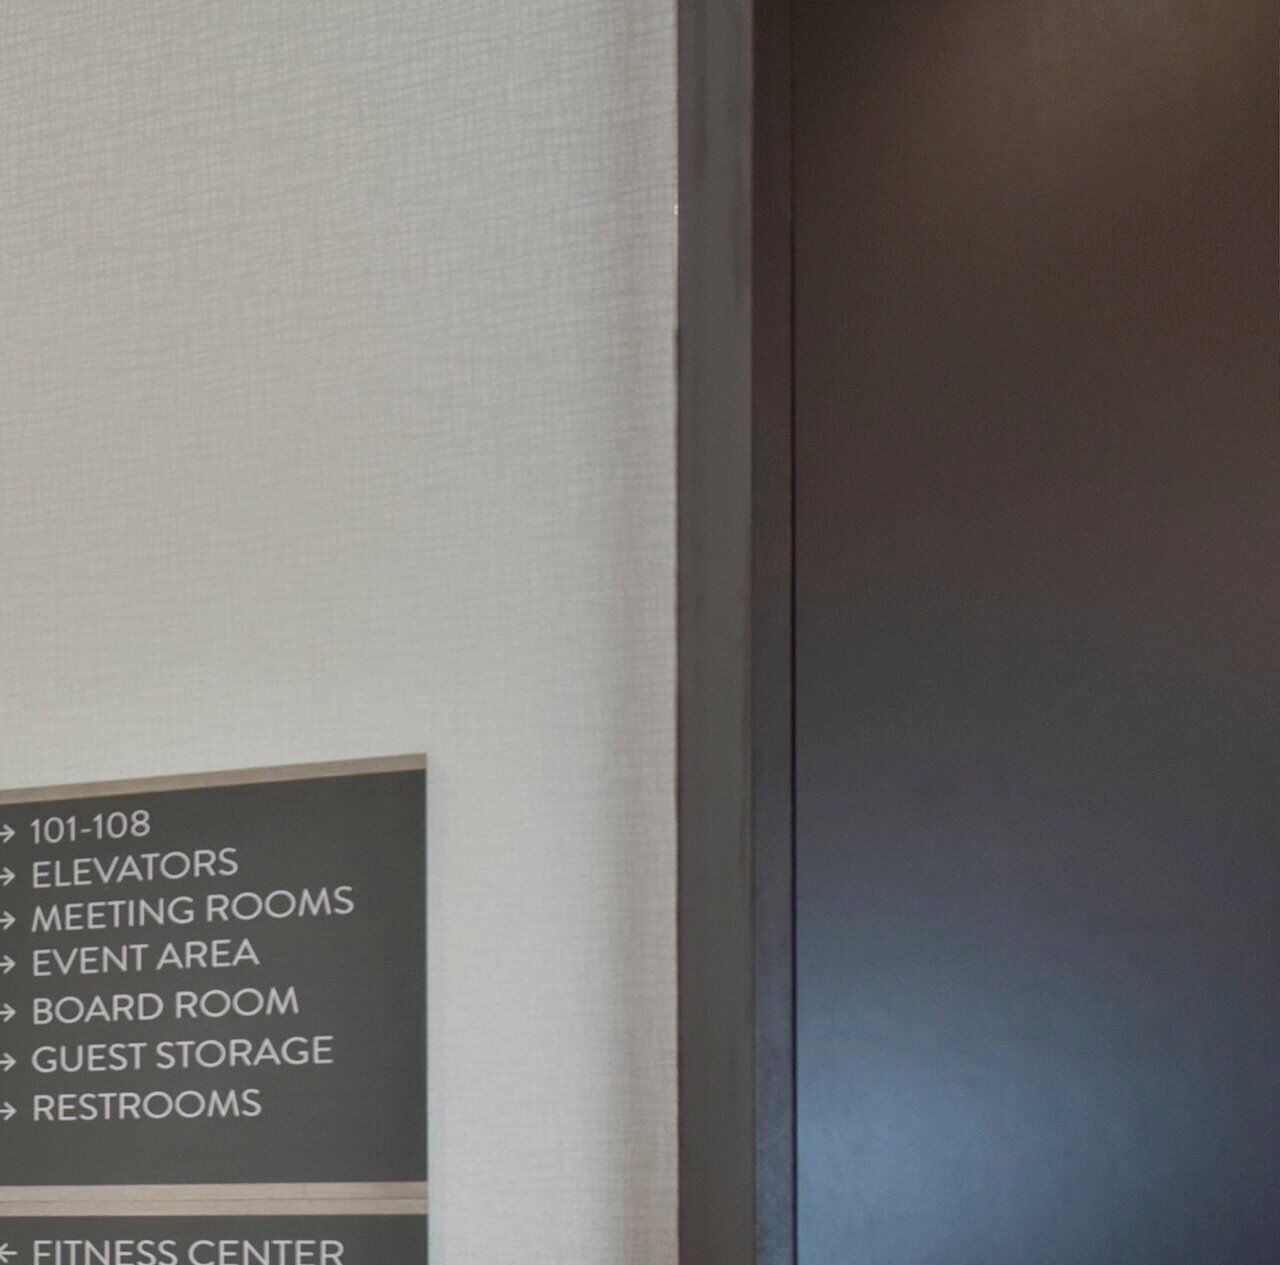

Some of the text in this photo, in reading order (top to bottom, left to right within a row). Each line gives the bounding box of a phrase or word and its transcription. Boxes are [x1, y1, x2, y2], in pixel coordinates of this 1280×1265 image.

[30, 809, 151, 845] 101-108
[32, 847, 239, 889] ELEVATORS
[31, 886, 355, 933] MEETING ROOMS
[32, 938, 260, 977] EVENT AREA
[32, 986, 300, 1025] BOARD ROOM
[31, 1036, 334, 1074] GUEST STORAGE
[32, 1088, 262, 1121] RESTROOMS
